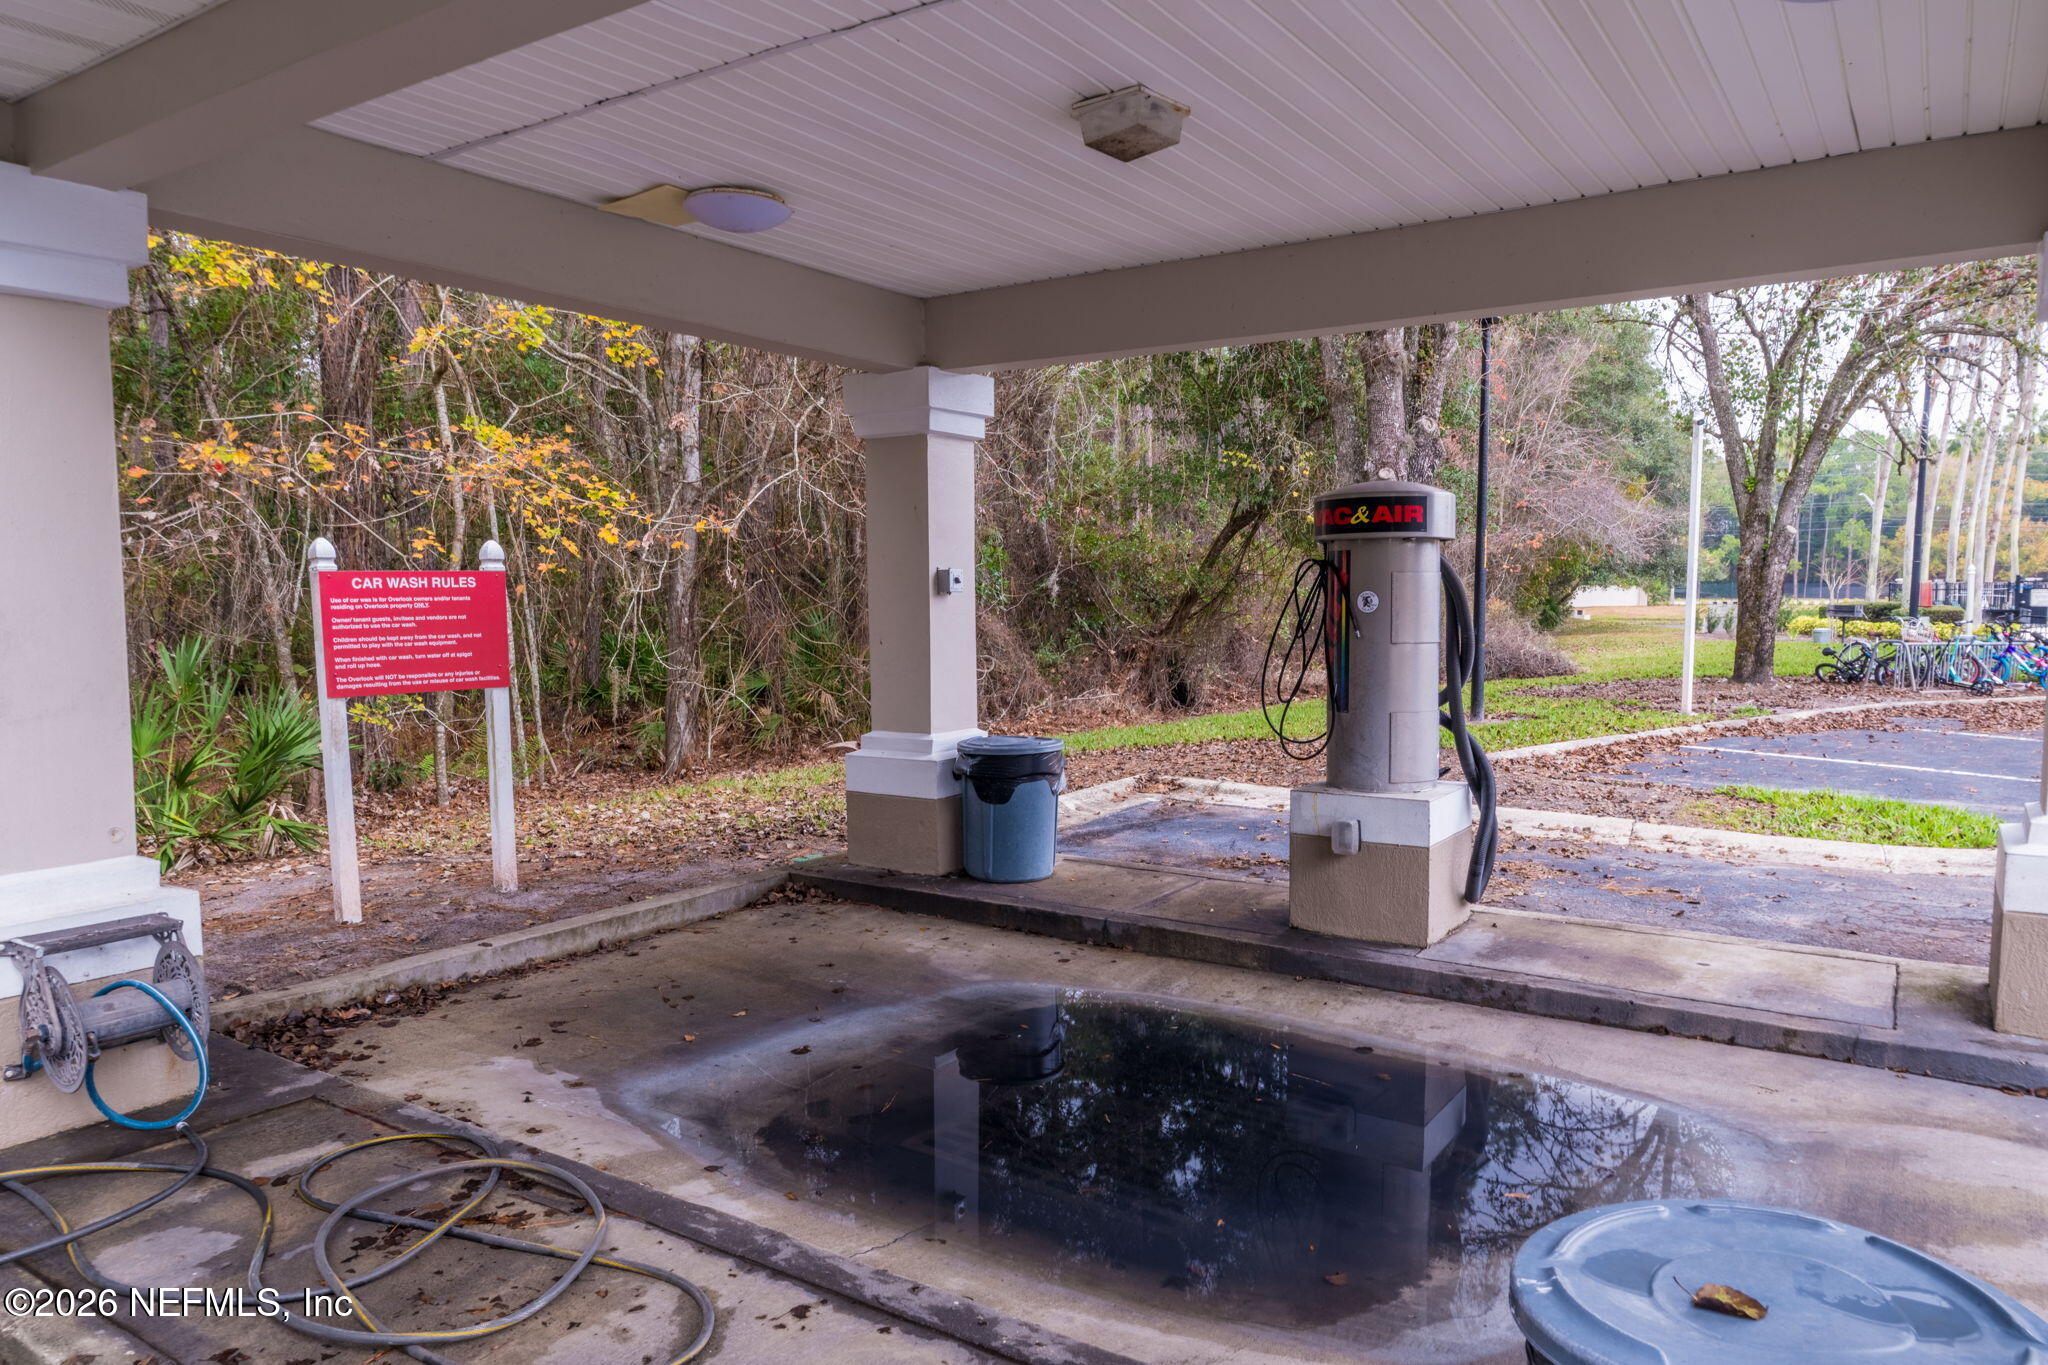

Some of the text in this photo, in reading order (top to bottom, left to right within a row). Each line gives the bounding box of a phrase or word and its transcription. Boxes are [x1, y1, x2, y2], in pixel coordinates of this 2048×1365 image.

[352, 577, 477, 589] CAR WASH RULES
